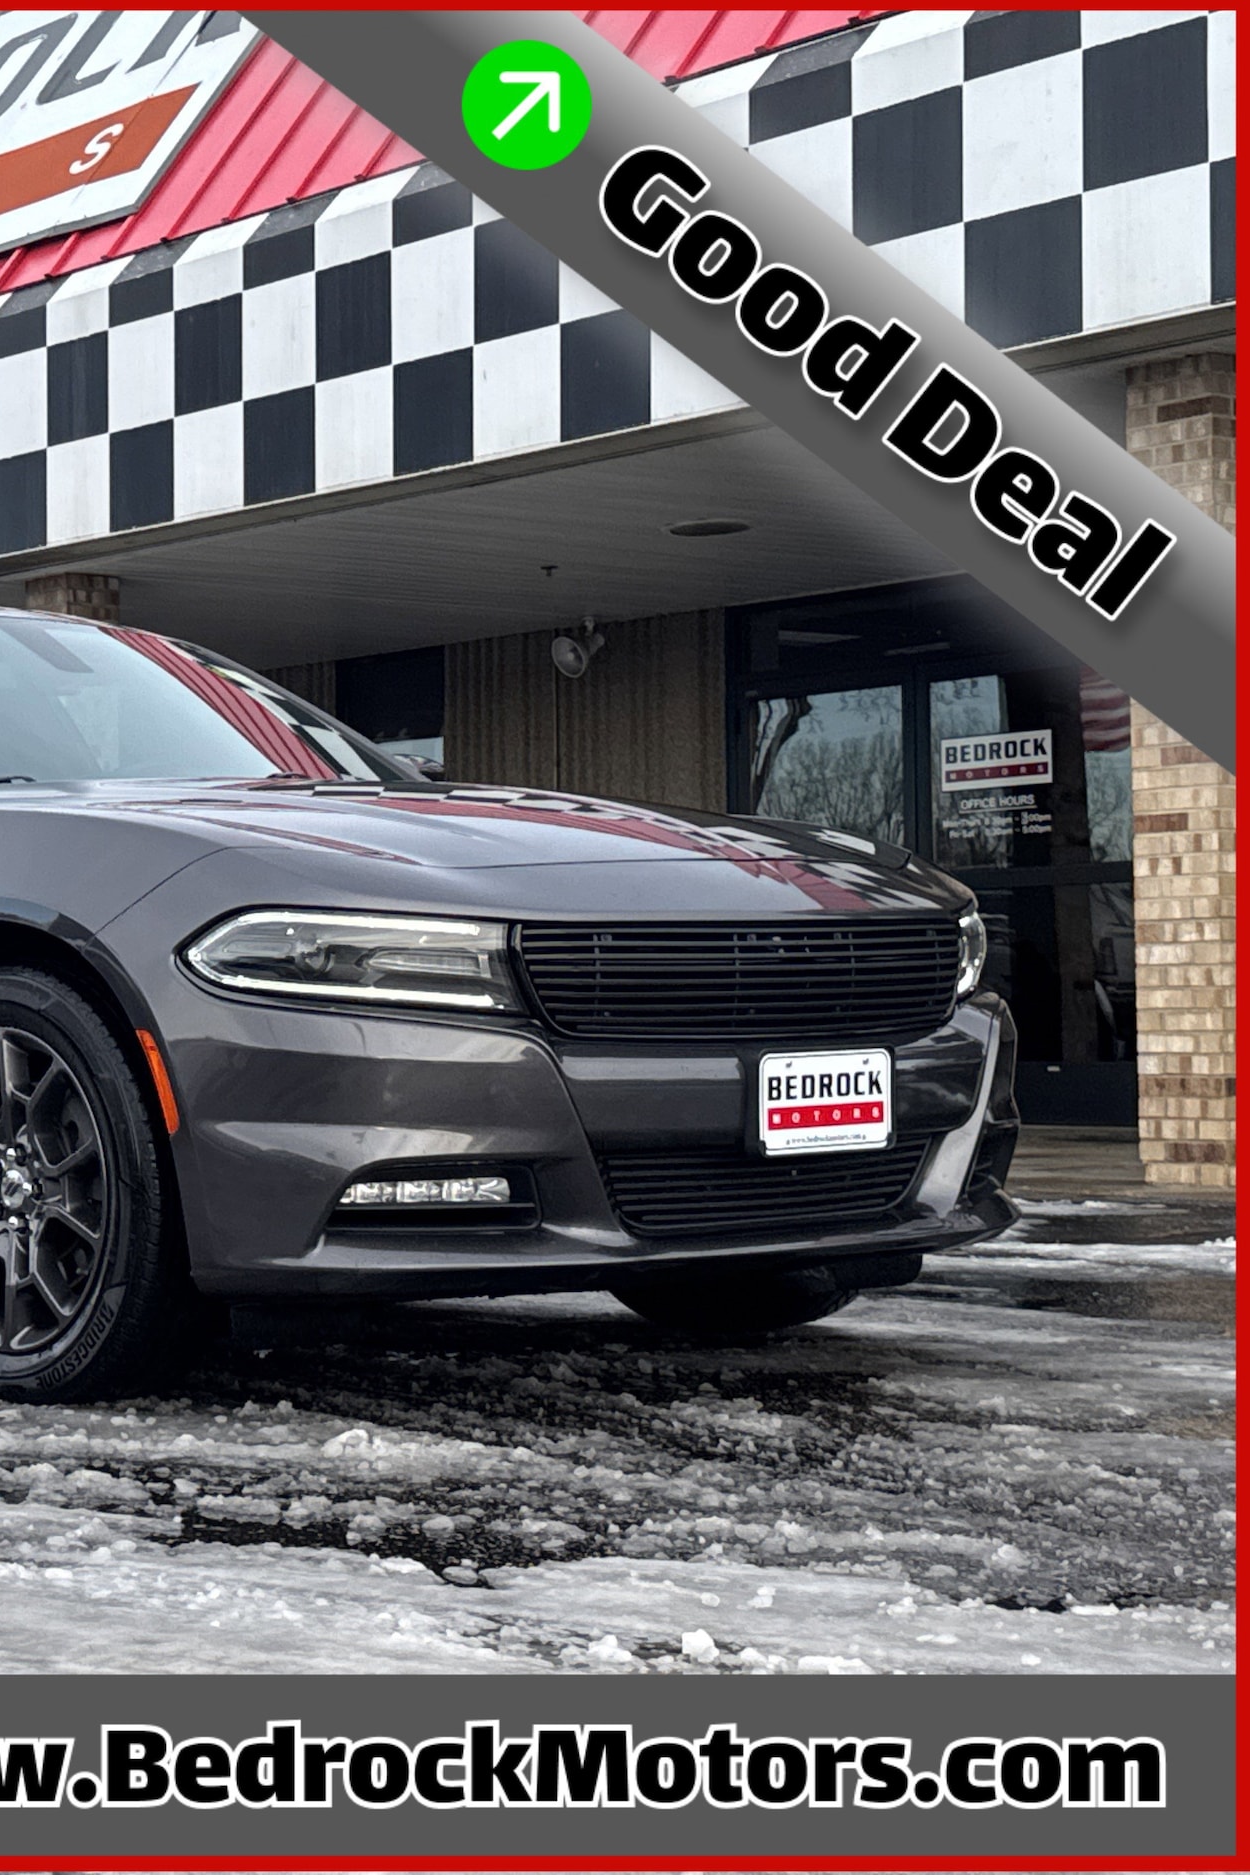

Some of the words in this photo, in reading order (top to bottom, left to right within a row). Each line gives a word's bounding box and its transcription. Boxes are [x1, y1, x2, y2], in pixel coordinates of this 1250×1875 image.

[945, 738, 1047, 763] BEDROCK
[950, 765, 1044, 780] MOTORS
[961, 797, 996, 810] OFFICE
[999, 794, 1035, 807] HOURS
[768, 1071, 882, 1101] BEDROCK
[772, 1106, 880, 1124] MOTORS
